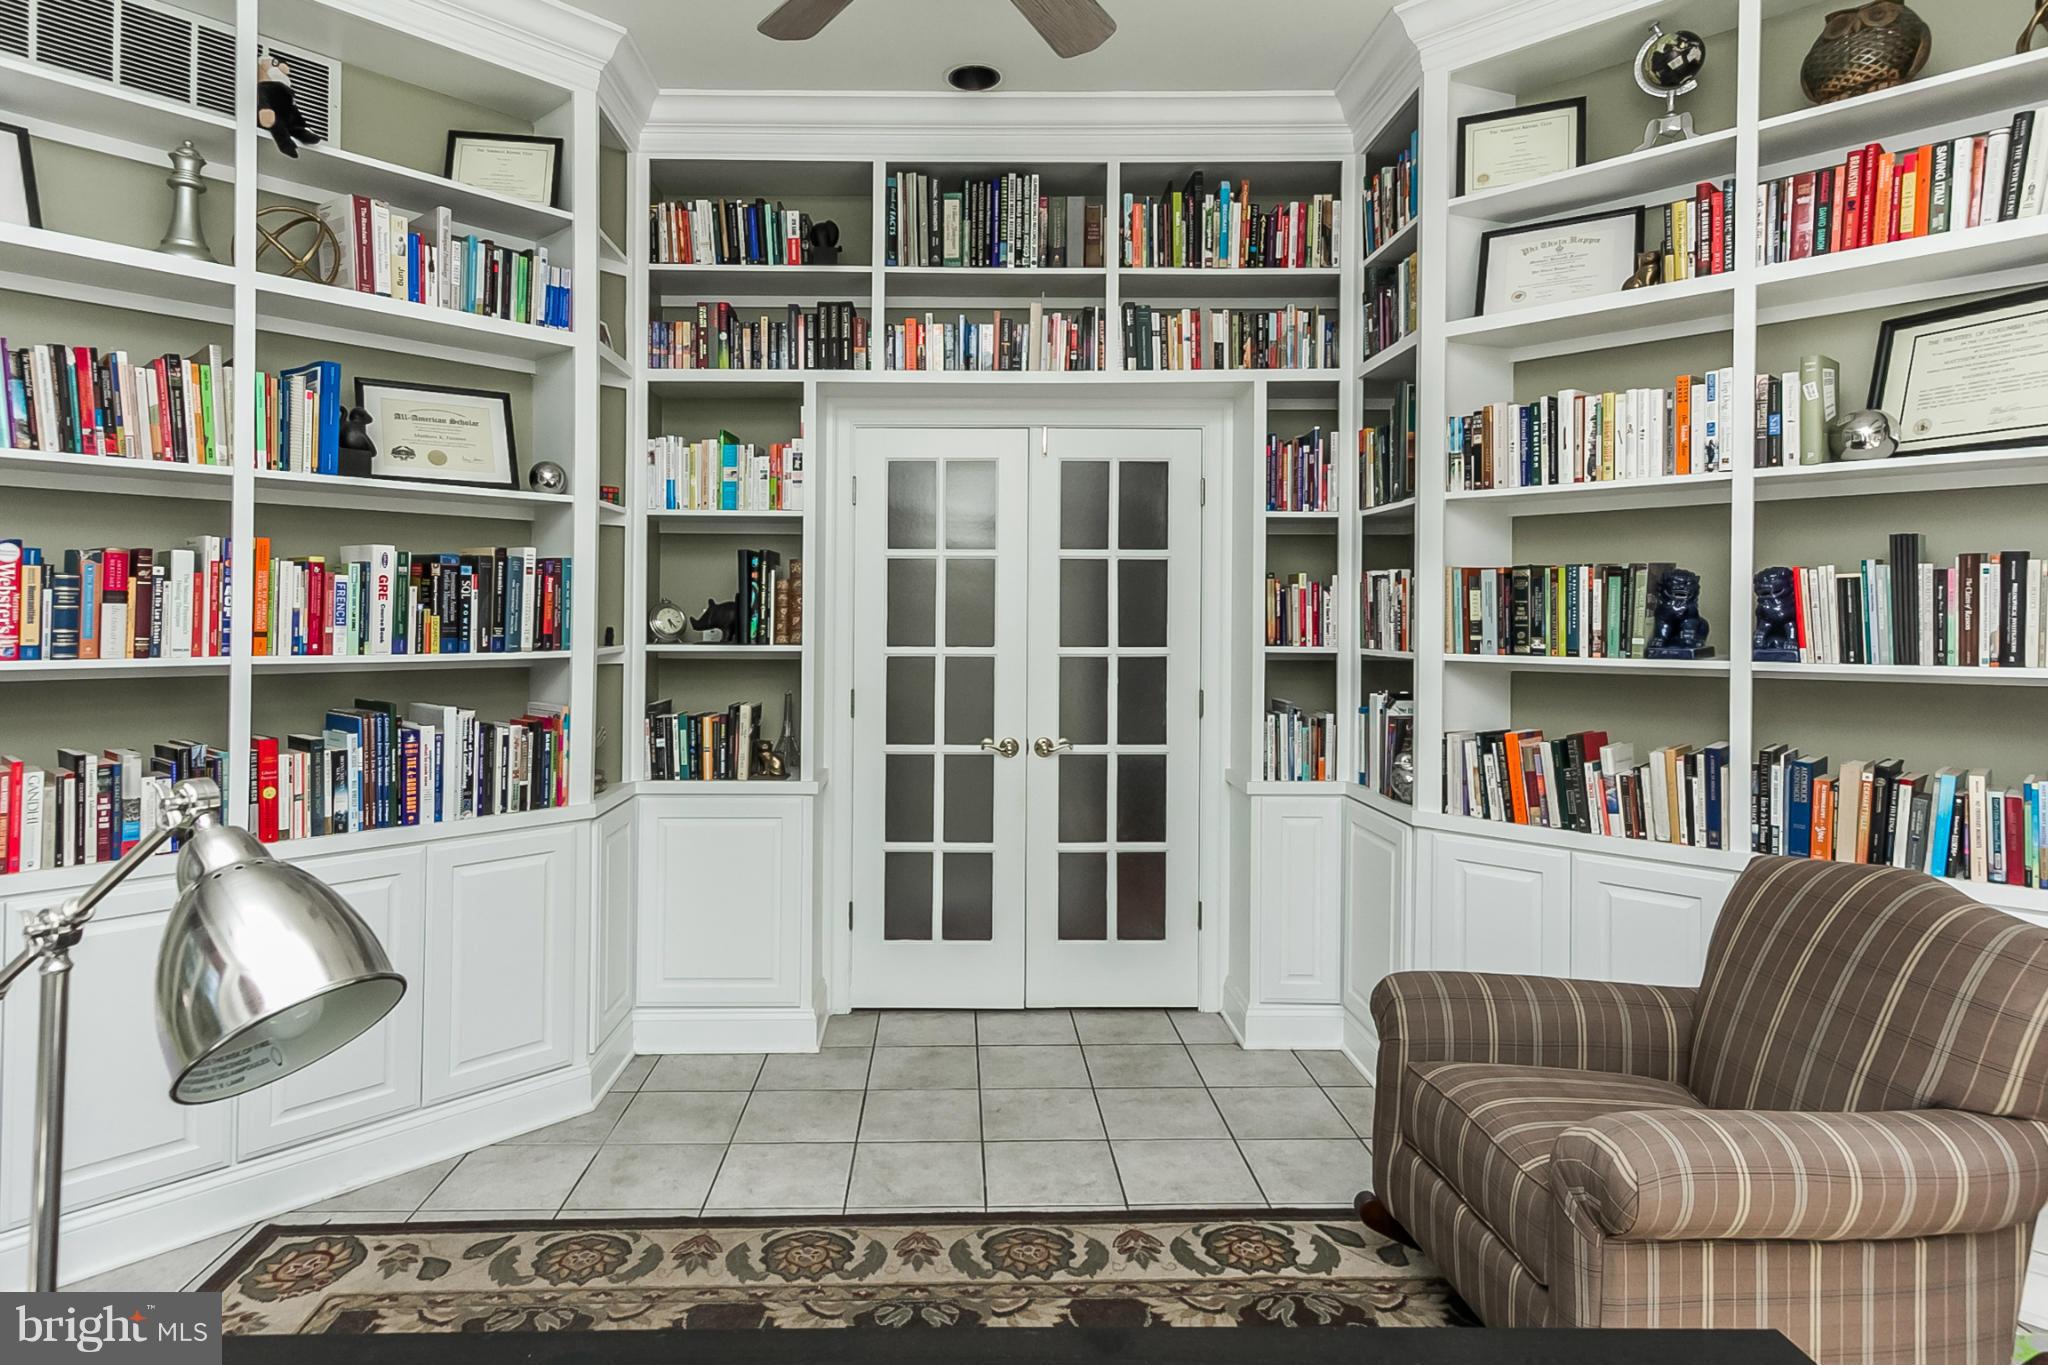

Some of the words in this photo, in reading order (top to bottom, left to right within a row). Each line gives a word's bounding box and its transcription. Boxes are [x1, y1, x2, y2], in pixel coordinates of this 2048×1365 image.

[1935, 145, 1948, 180] SAVING
[2013, 144, 2023, 160] THE
[1848, 156, 1860, 198] BRAINSTORM
[2010, 162, 2020, 192] SPORTS
[1702, 199, 1710, 210] THE
[1934, 182, 1945, 206] ITALY
[2006, 194, 2016, 216] GENE
[1702, 212, 1710, 240] BURNING
[1724, 214, 1733, 234] ERIC
[1818, 207, 1828, 226] DAVID
[1817, 228, 1826, 250] SIMON
[1702, 242, 1710, 262] SHORE
[1724, 235, 1733, 270] METAXAS
[398, 267, 406, 286] Jung
[394, 412, 447, 424] All-American
[449, 418, 480, 427] Scholar
[1770, 416, 1780, 432] Salt
[153, 577, 164, 596] Inside
[378, 574, 389, 601] GRE
[460, 580, 471, 599] SQL
[0, 562, 18, 635] Webster's
[26, 585, 38, 624] Humanities
[153, 598, 164, 607] the
[336, 583, 346, 624] FRENCH
[442, 592, 450, 623] Management
[2011, 582, 2019, 617] PHILOSOPHICAL
[153, 608, 164, 620] Law
[378, 604, 389, 626] Course
[153, 622, 164, 645] Schools
[378, 628, 389, 644] Book
[2011, 618, 2019, 653] INVESTIGATIONS
[406, 756, 417, 769] THE
[406, 770, 417, 796] 4-HOUR
[26, 775, 40, 825] GANDHI
[406, 796, 417, 814] BODY
[1862, 782, 1870, 810] ECKHART
